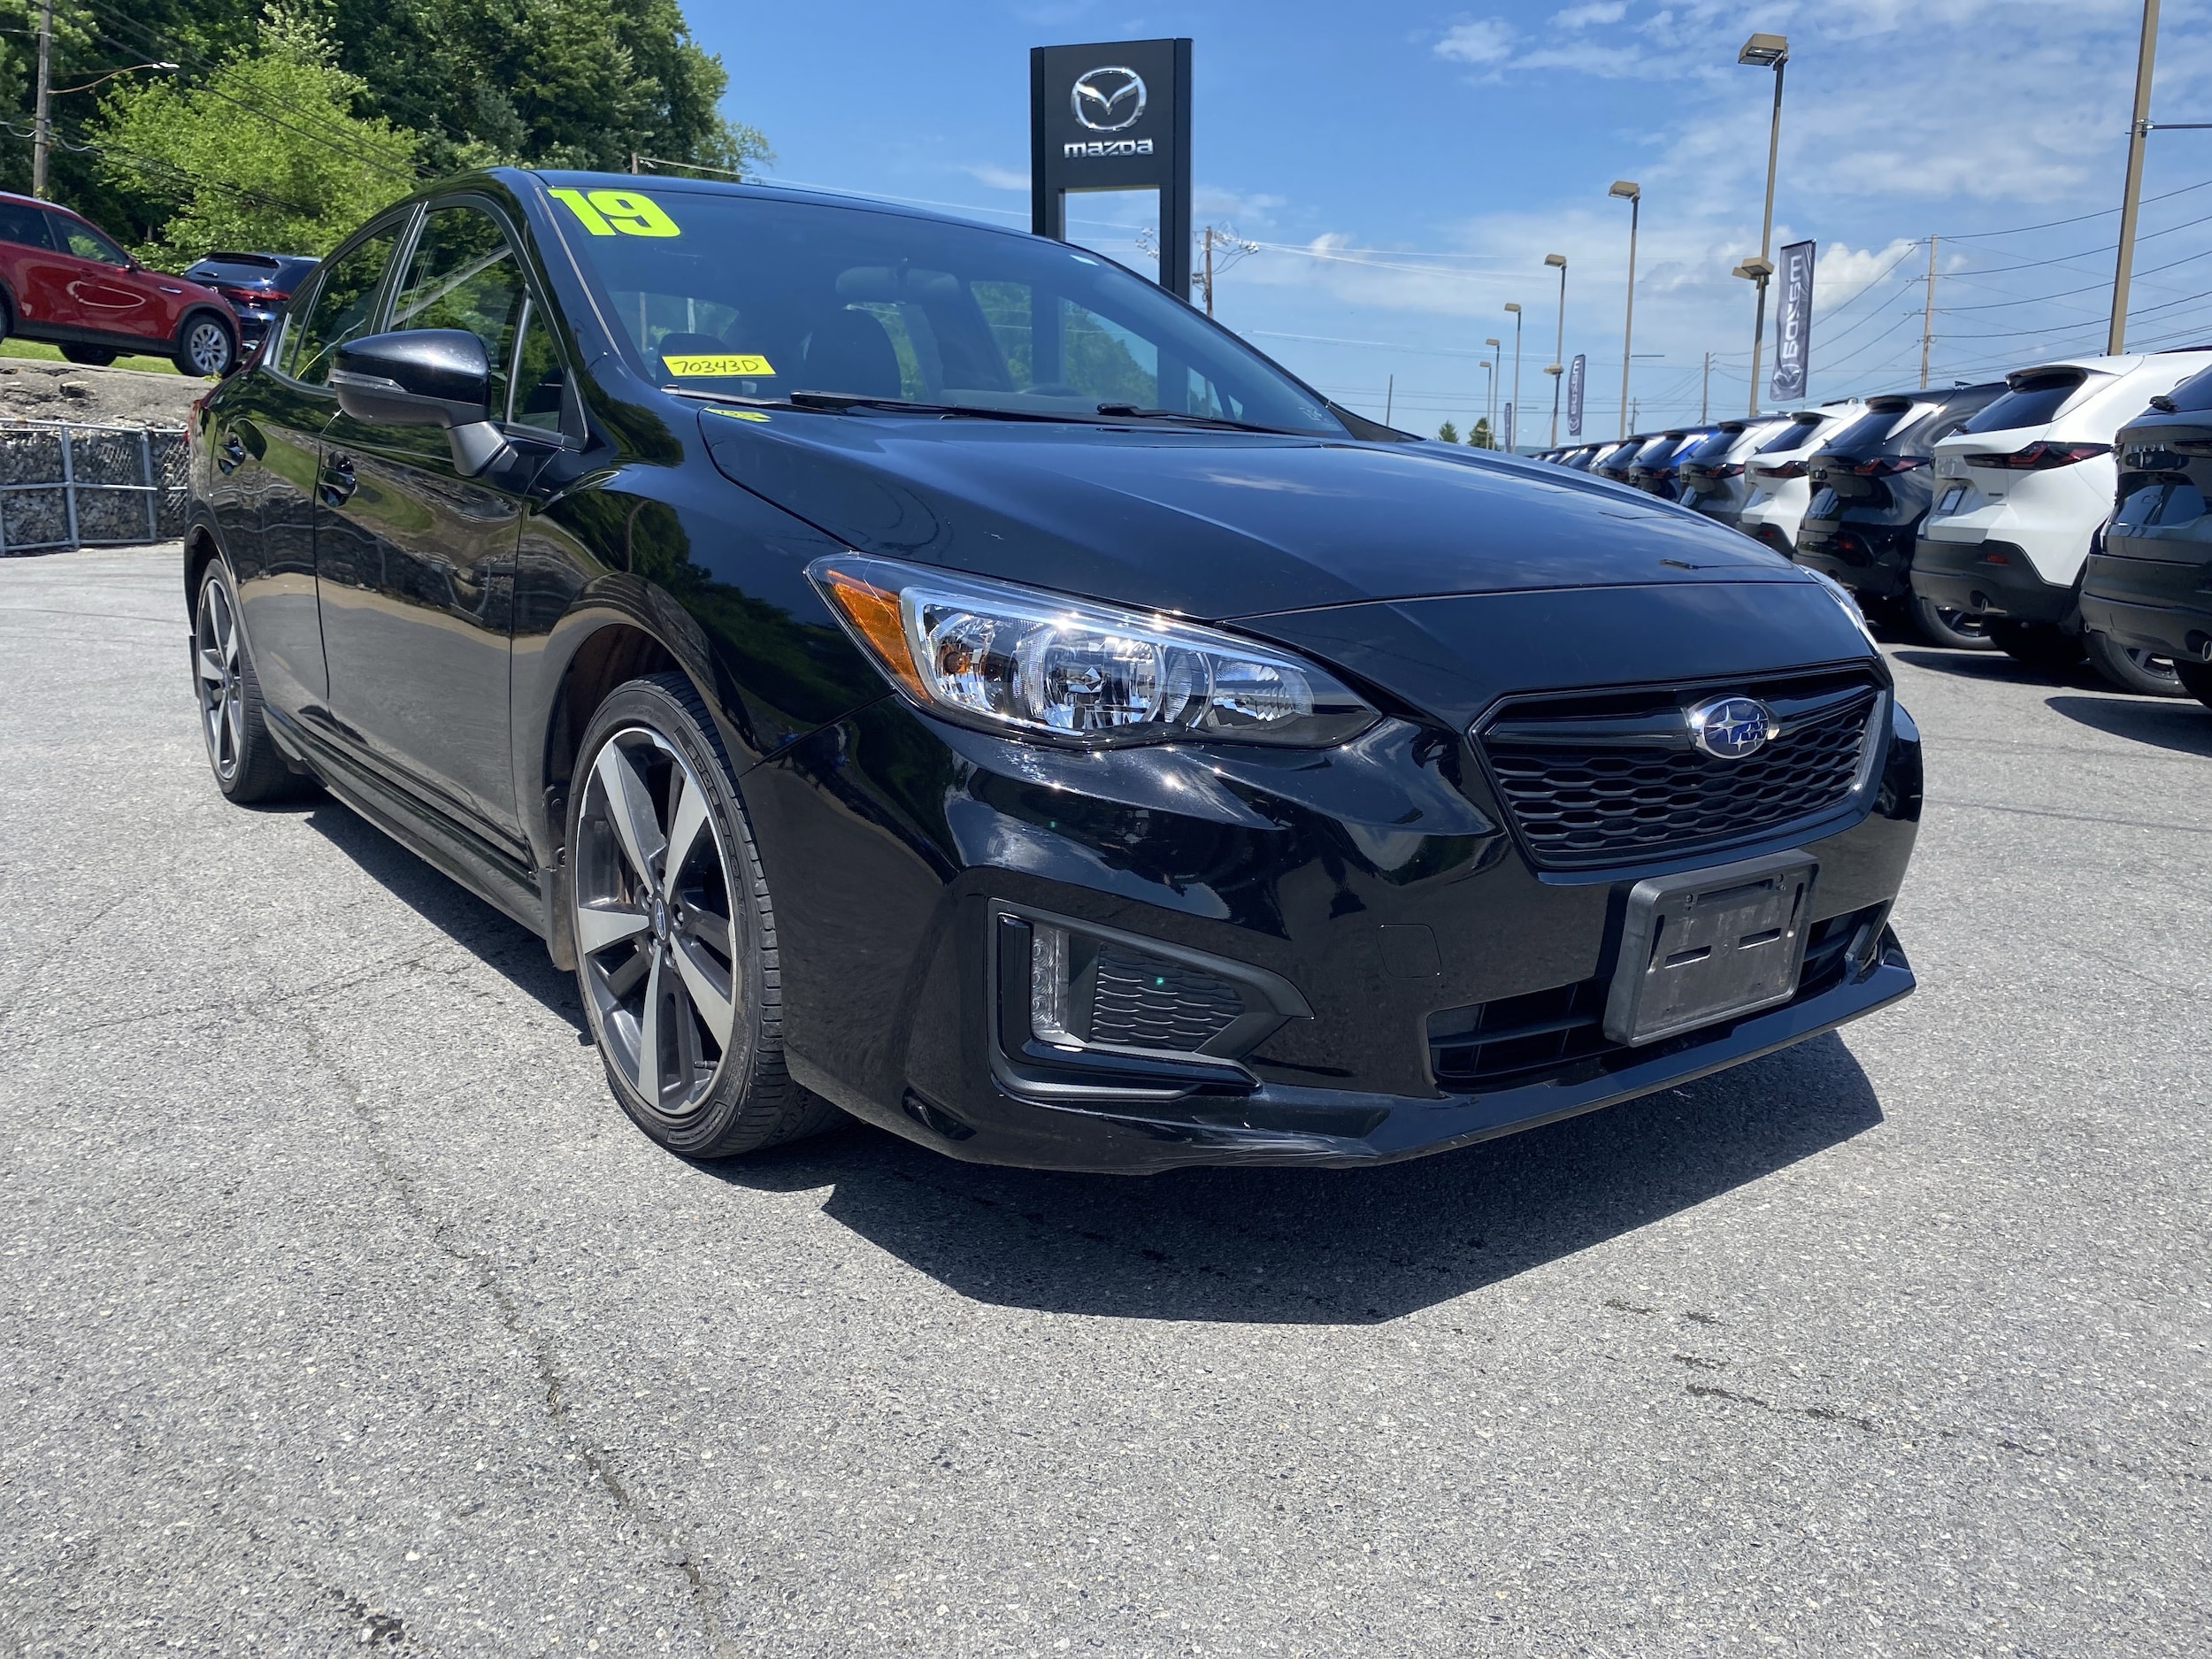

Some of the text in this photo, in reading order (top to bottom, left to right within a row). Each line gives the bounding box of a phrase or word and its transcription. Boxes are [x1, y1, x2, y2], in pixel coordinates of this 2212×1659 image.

[1064, 138, 1154, 158] mazda
[547, 188, 680, 237] 19
[672, 360, 759, 373] 70343D
